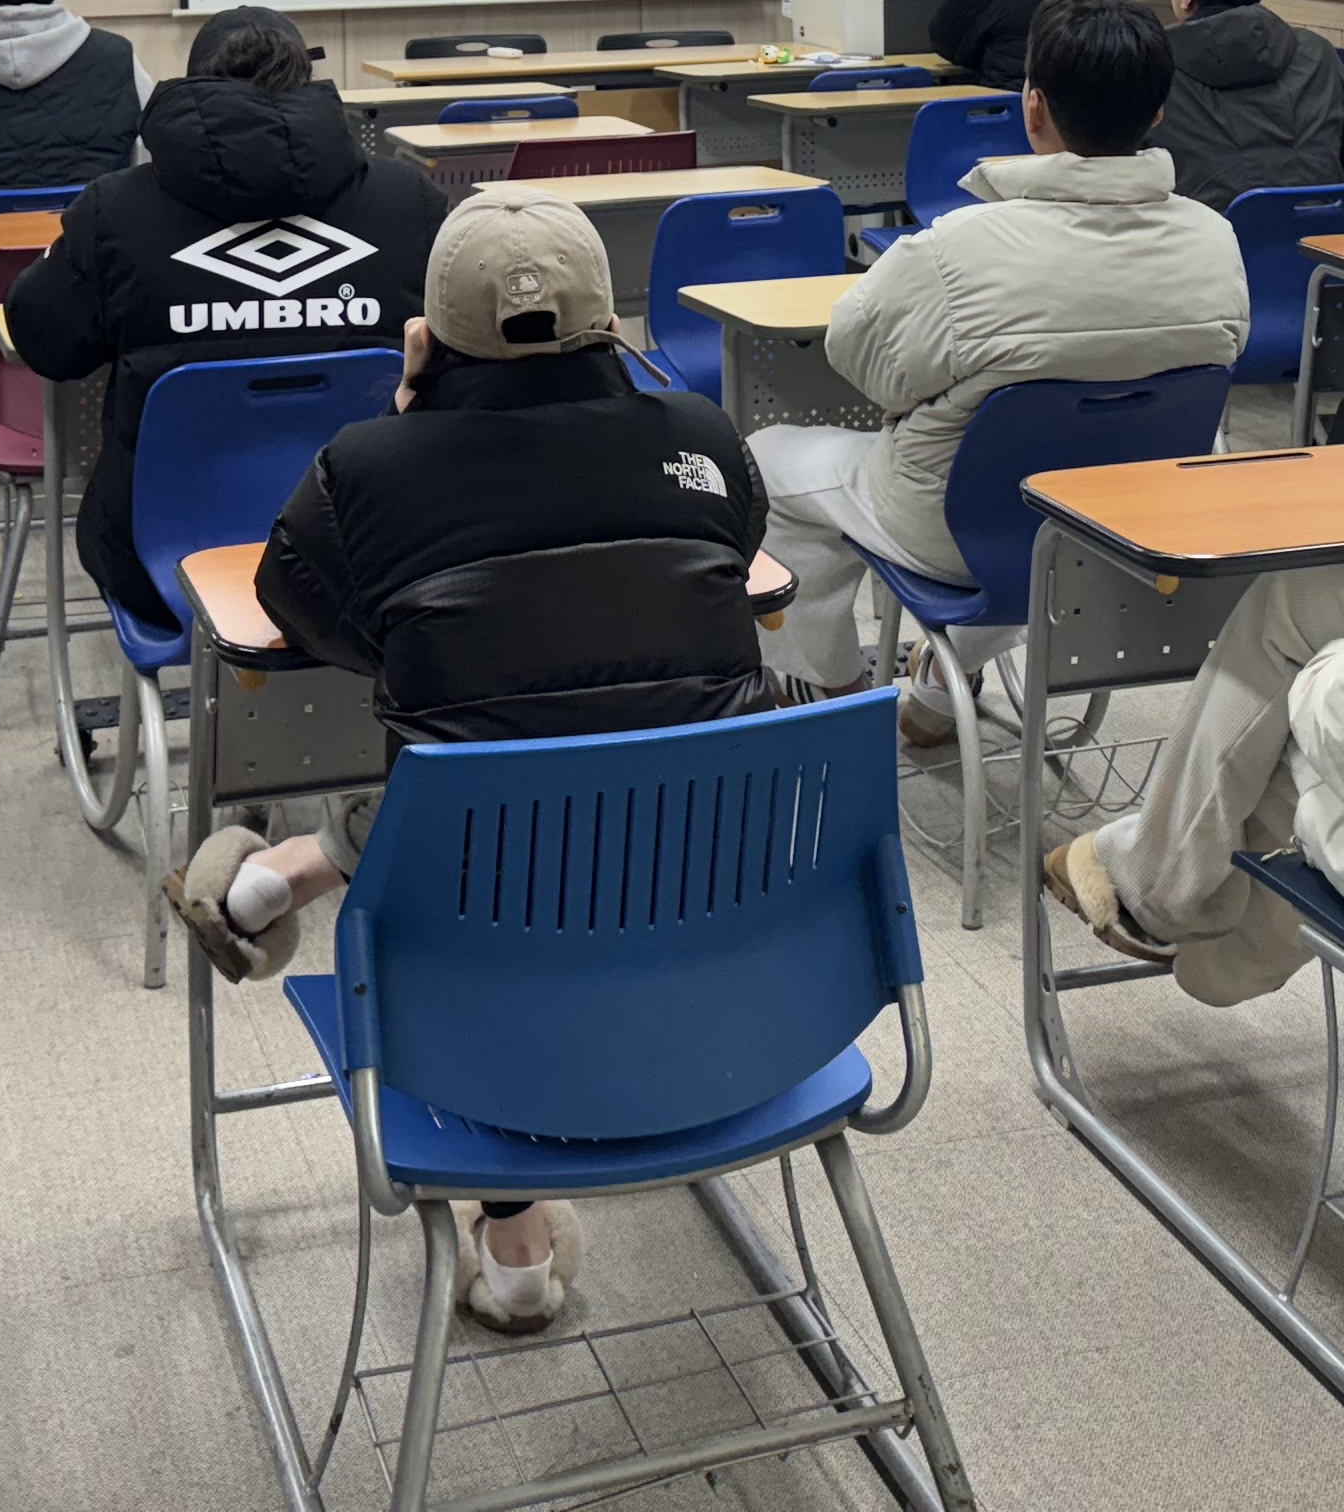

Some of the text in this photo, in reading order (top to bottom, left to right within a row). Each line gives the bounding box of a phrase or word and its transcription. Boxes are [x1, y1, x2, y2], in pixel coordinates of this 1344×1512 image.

[169, 297, 381, 334] UMBRO
[678, 451, 704, 466] THE
[662, 462, 707, 479] NORTH
[678, 475, 710, 492] FACE
